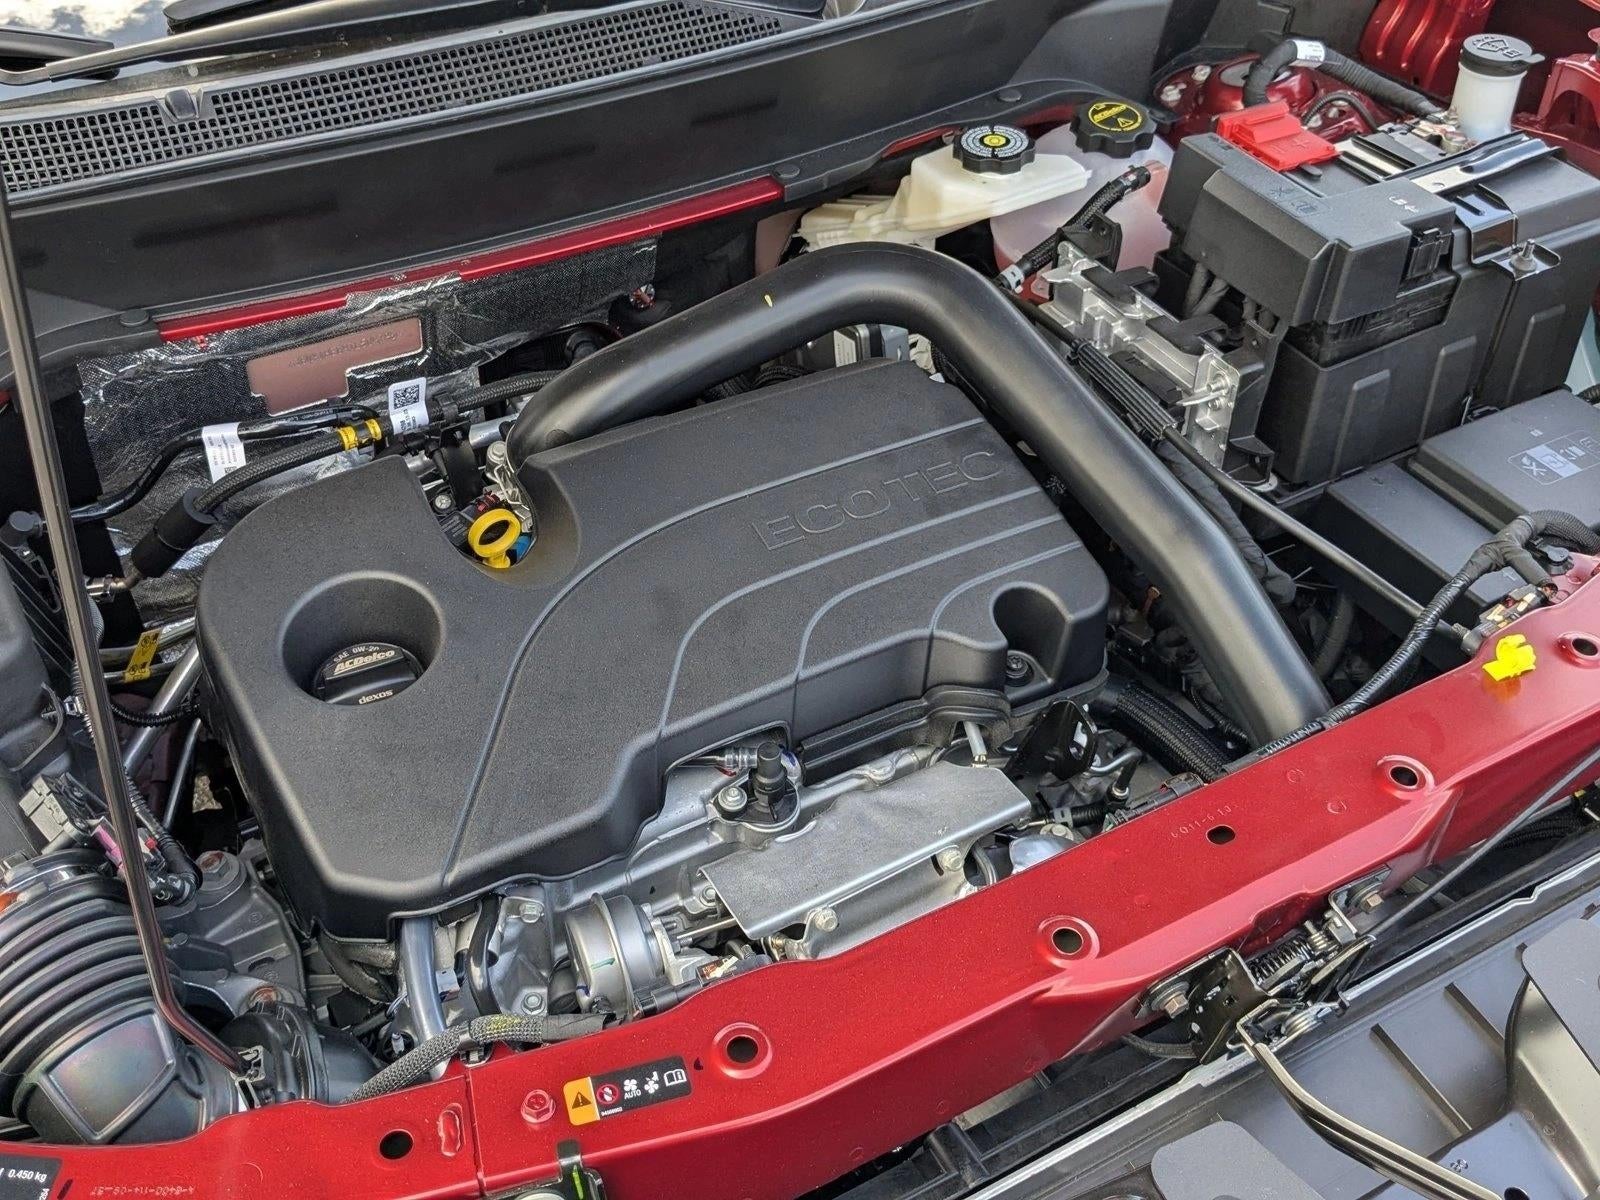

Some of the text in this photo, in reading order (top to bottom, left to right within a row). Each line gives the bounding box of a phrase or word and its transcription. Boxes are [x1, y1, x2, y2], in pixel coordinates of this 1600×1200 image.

[749, 452, 1001, 550] ECOTEC
[333, 650, 350, 664] SAE
[333, 650, 395, 675] ACDelco
[358, 689, 394, 705] dexos
[624, 1088, 642, 1100] AUTO
[8, 1168, 34, 1180] 0.450
[34, 1171, 47, 1183] kg
